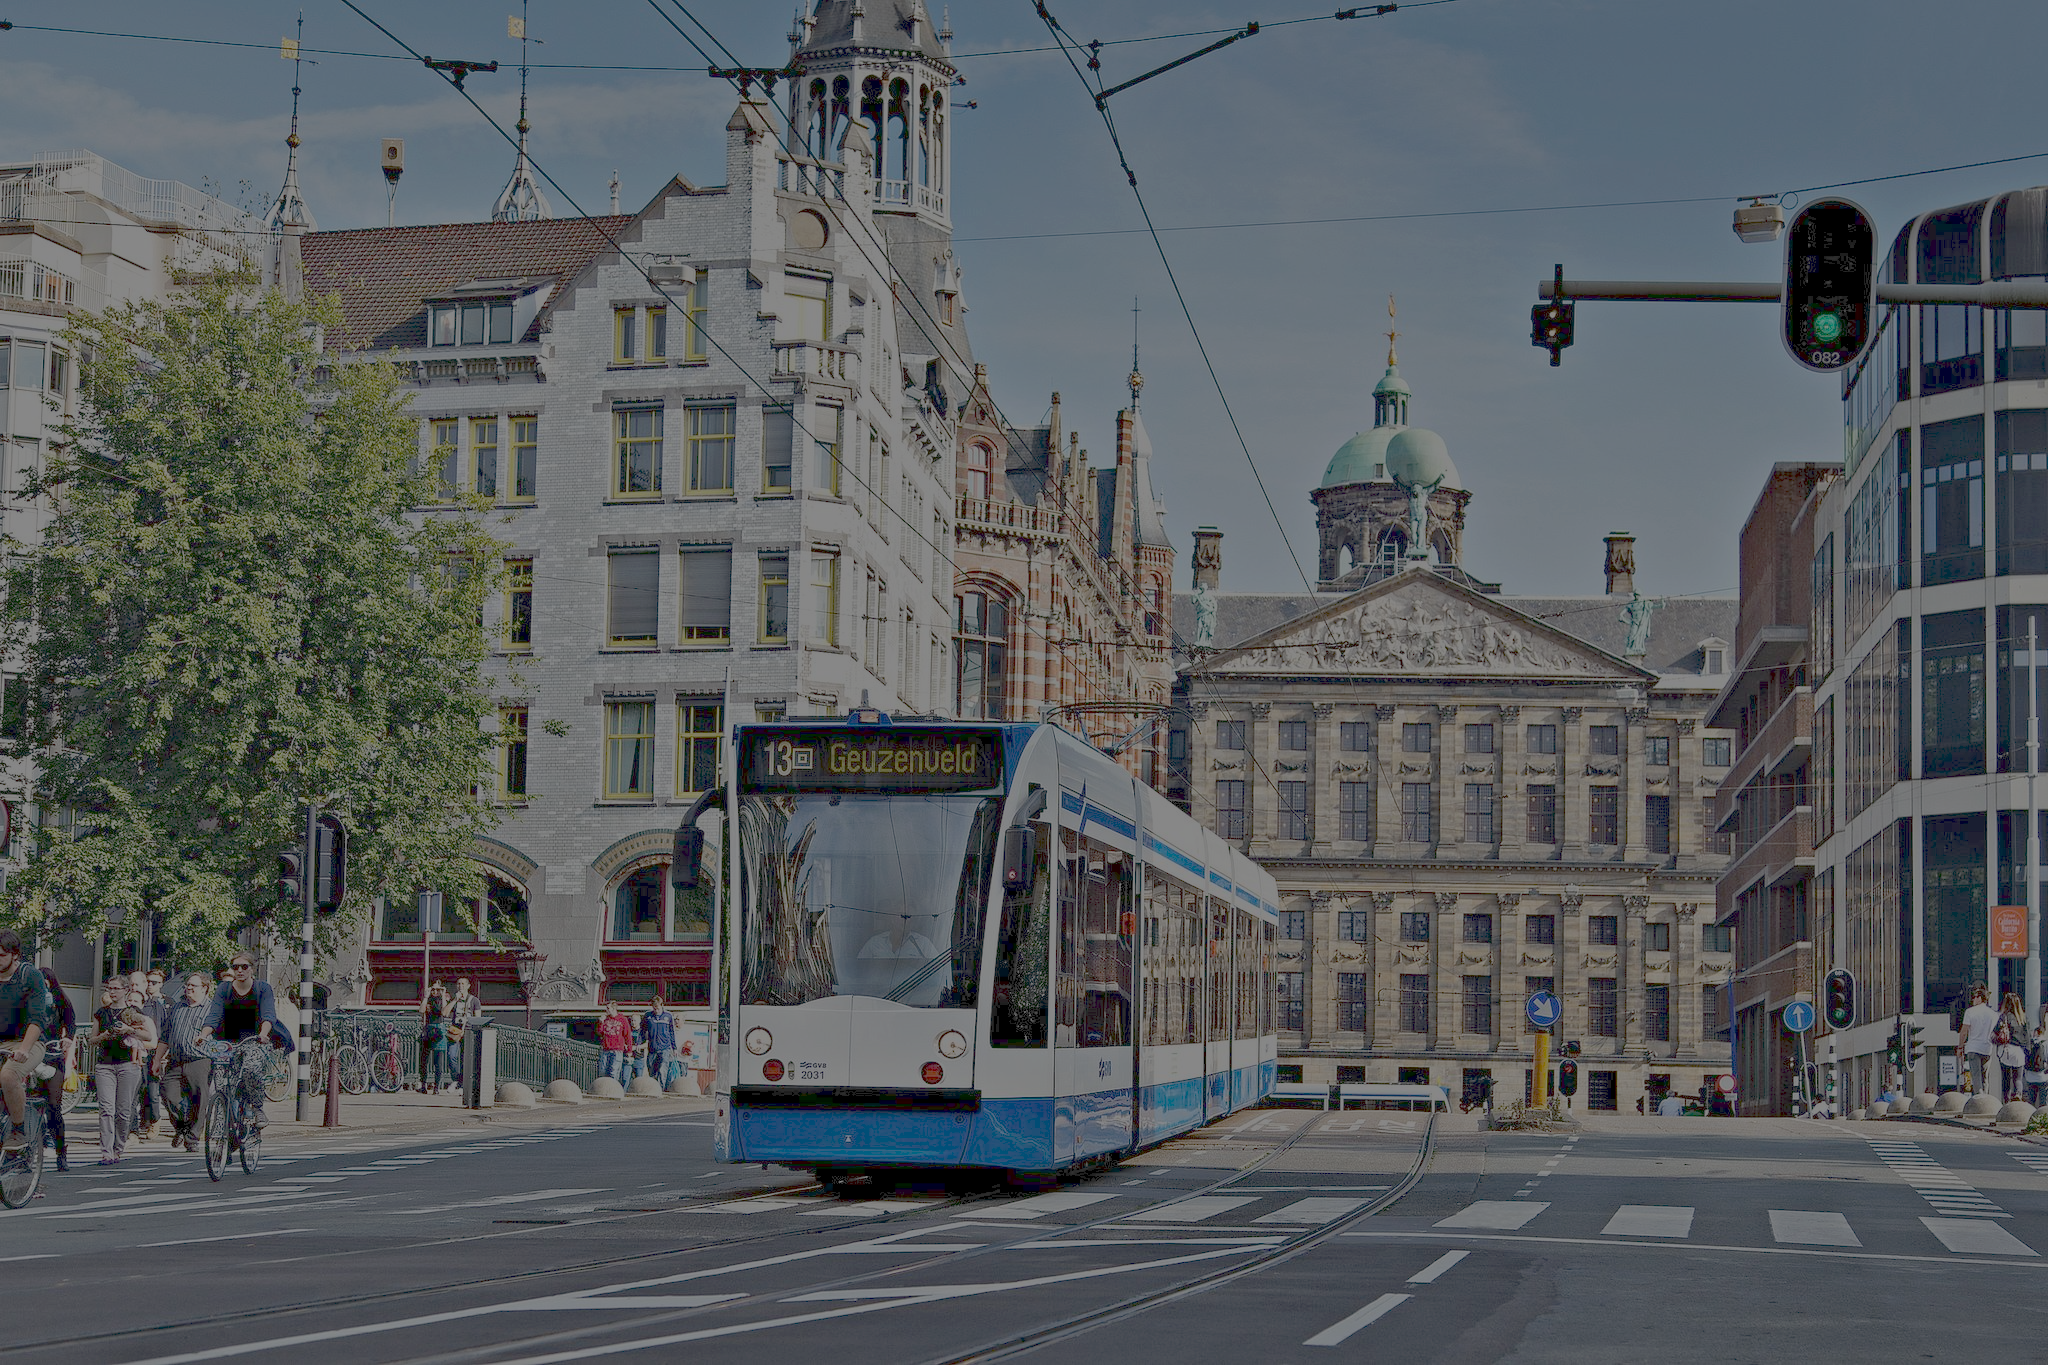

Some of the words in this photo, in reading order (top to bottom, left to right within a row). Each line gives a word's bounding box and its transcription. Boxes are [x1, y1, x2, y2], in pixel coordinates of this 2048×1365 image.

[1811, 351, 1841, 365] 082
[764, 740, 793, 776] 13
[829, 742, 977, 774] Geuzenveld
[801, 1070, 824, 1079] 2031
